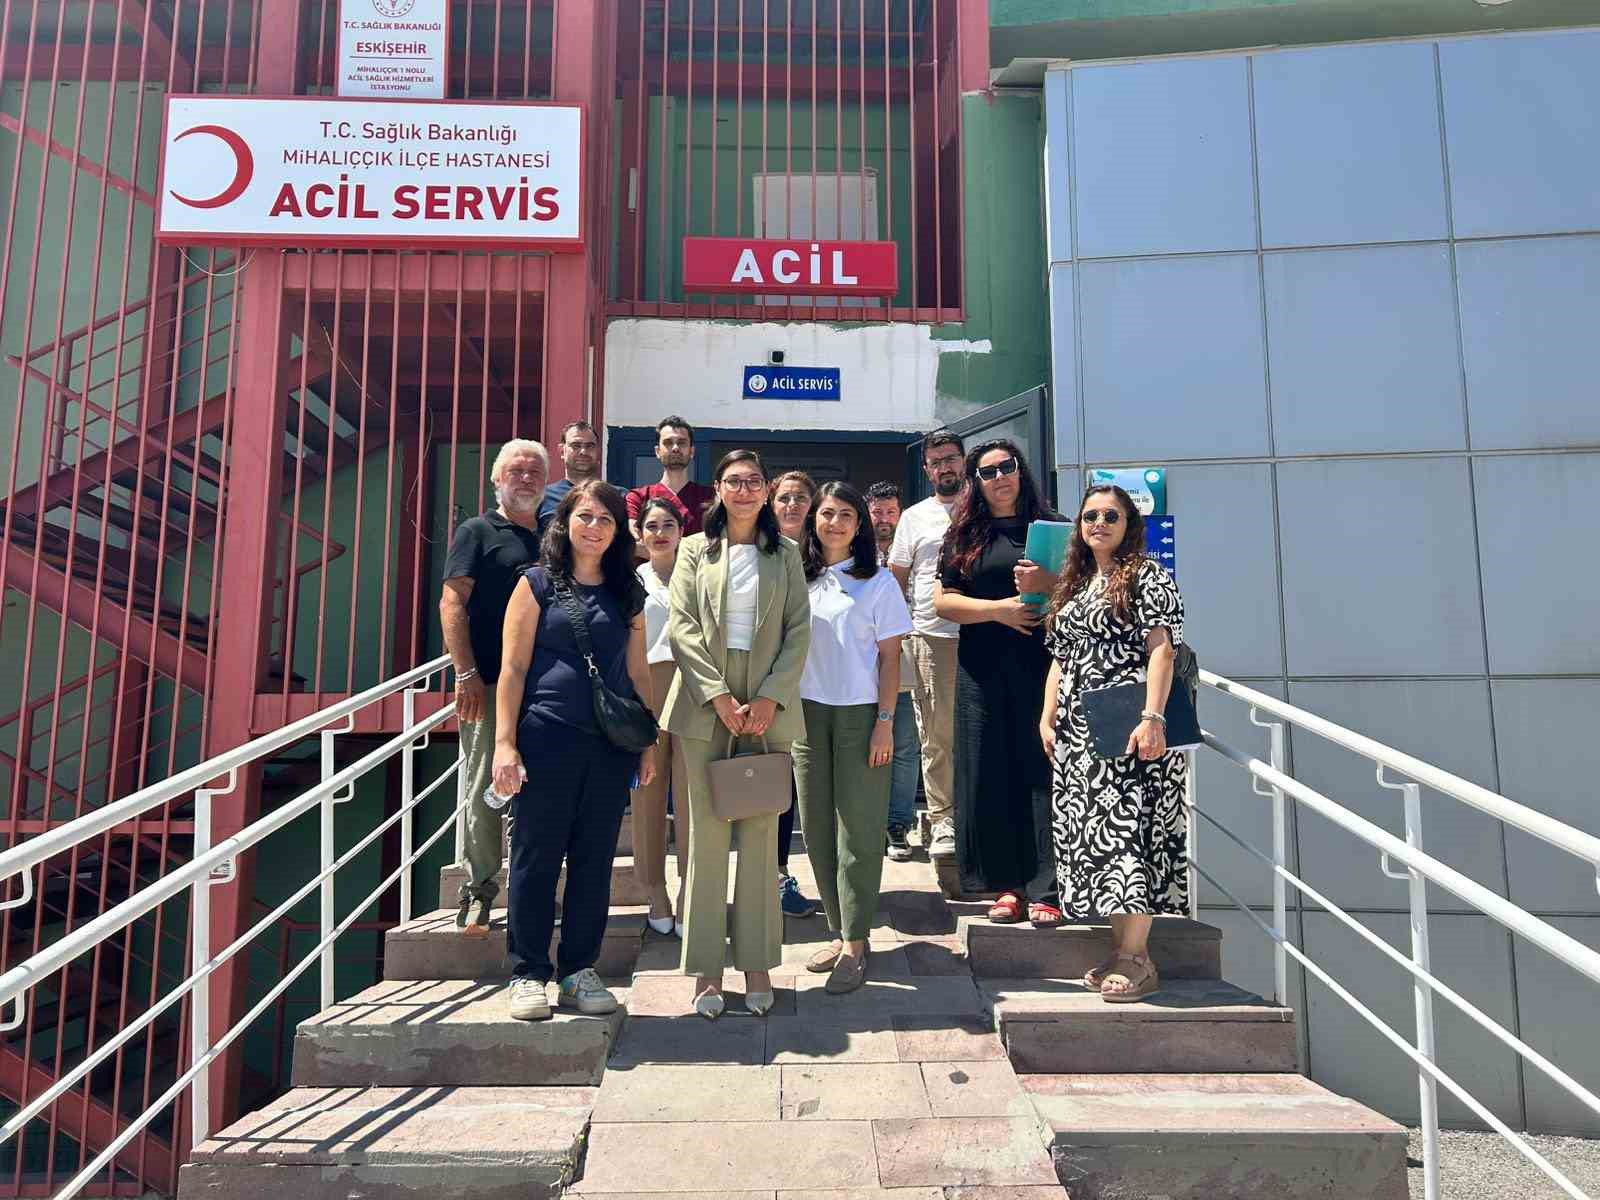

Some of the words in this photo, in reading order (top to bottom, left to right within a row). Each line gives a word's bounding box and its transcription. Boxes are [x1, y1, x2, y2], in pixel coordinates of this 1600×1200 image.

[344, 21, 360, 30] T.C.
[361, 20, 393, 30] SAĞLIK
[394, 21, 441, 31] BAKANLIĞI
[356, 40, 427, 56] ESKİŞEHİR
[405, 66, 426, 74] NOLU
[320, 121, 357, 139] T.C.
[362, 122, 422, 144] Sağlık
[428, 123, 517, 146] Bakanlığı
[399, 148, 440, 171] İLÇE
[446, 150, 551, 169] HASTANESİ
[268, 173, 380, 219] ACİL
[391, 176, 560, 221] SERVİS
[730, 243, 858, 286] ACİL
[772, 375, 796, 391] ACİL
[798, 375, 833, 391] SERVİS
